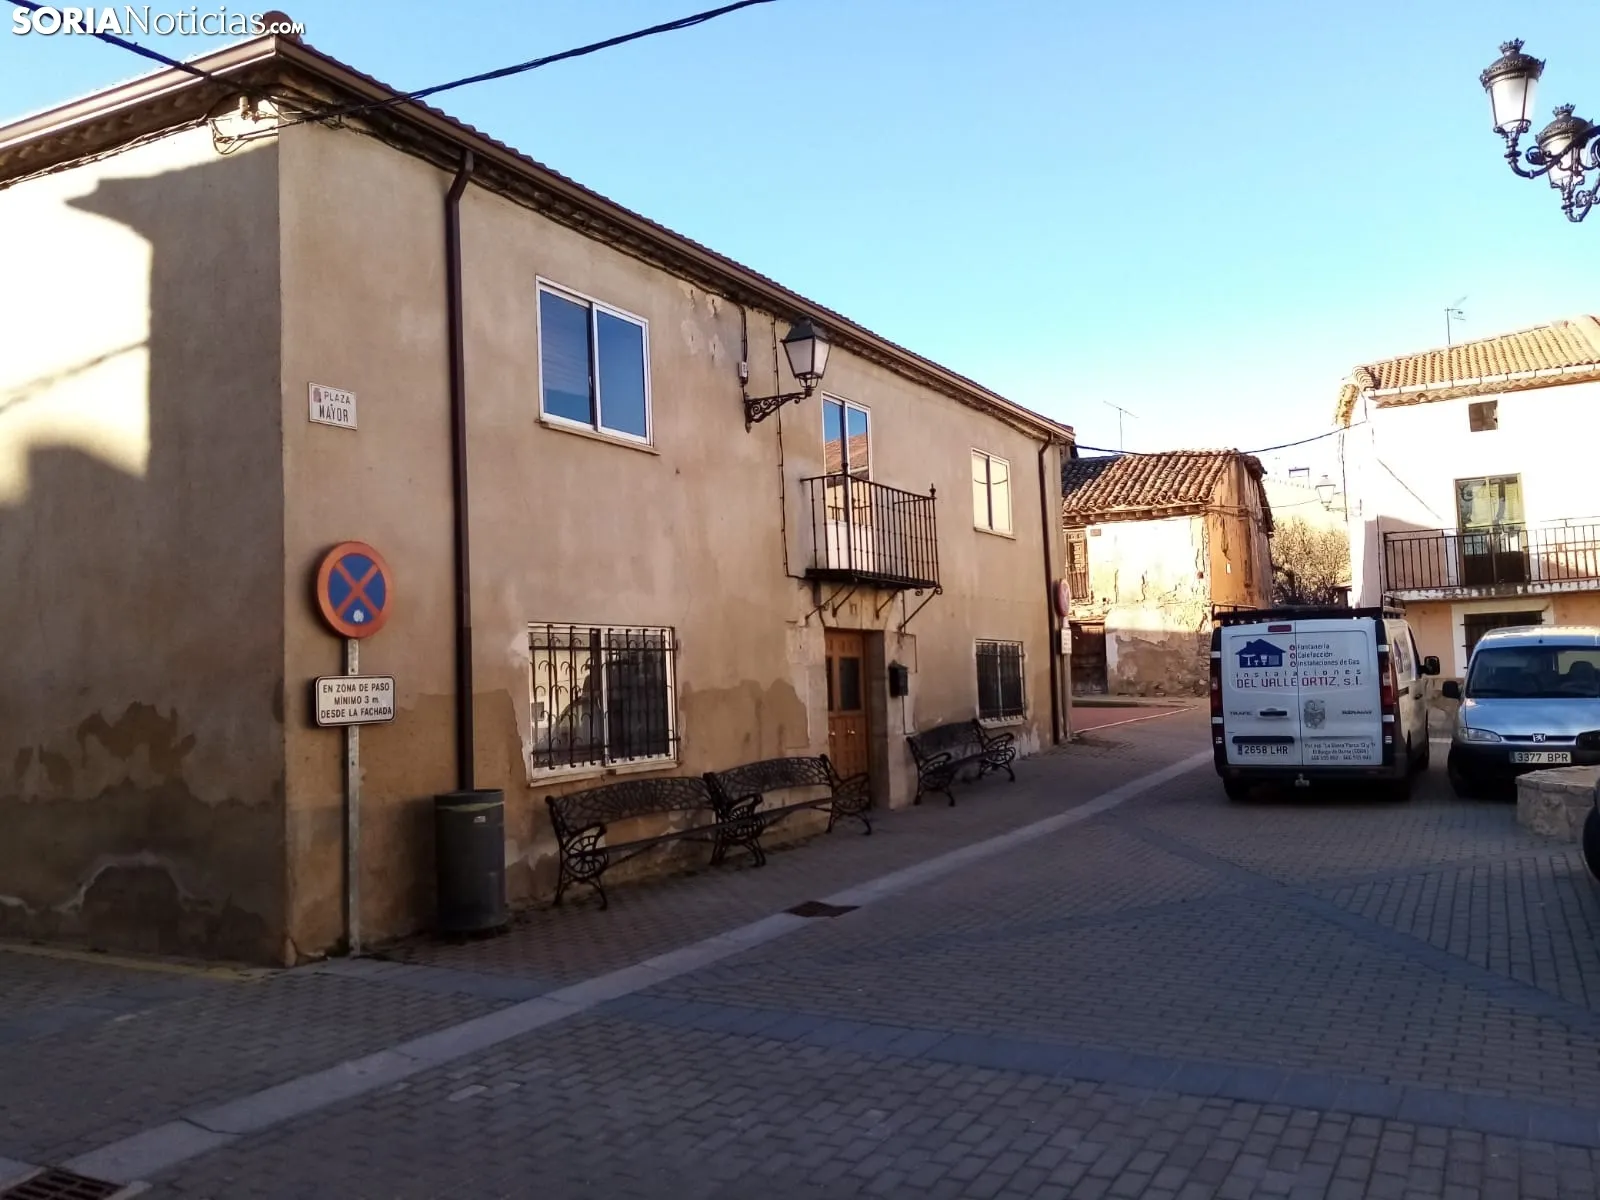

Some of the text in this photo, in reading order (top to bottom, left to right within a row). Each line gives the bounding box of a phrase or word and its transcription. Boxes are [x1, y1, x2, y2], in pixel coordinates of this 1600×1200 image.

[323, 391, 351, 405] PLAZA
[319, 404, 349, 423] MAYOR
[322, 682, 390, 694] EN ZONA DE PASO
[1236, 678, 1257, 689] DEL
[364, 695, 369, 704] 3
[320, 706, 392, 719] DESDE LA FACHADA
[1270, 744, 1289, 755] LHR
[1517, 752, 1569, 762] 3377 BPR
